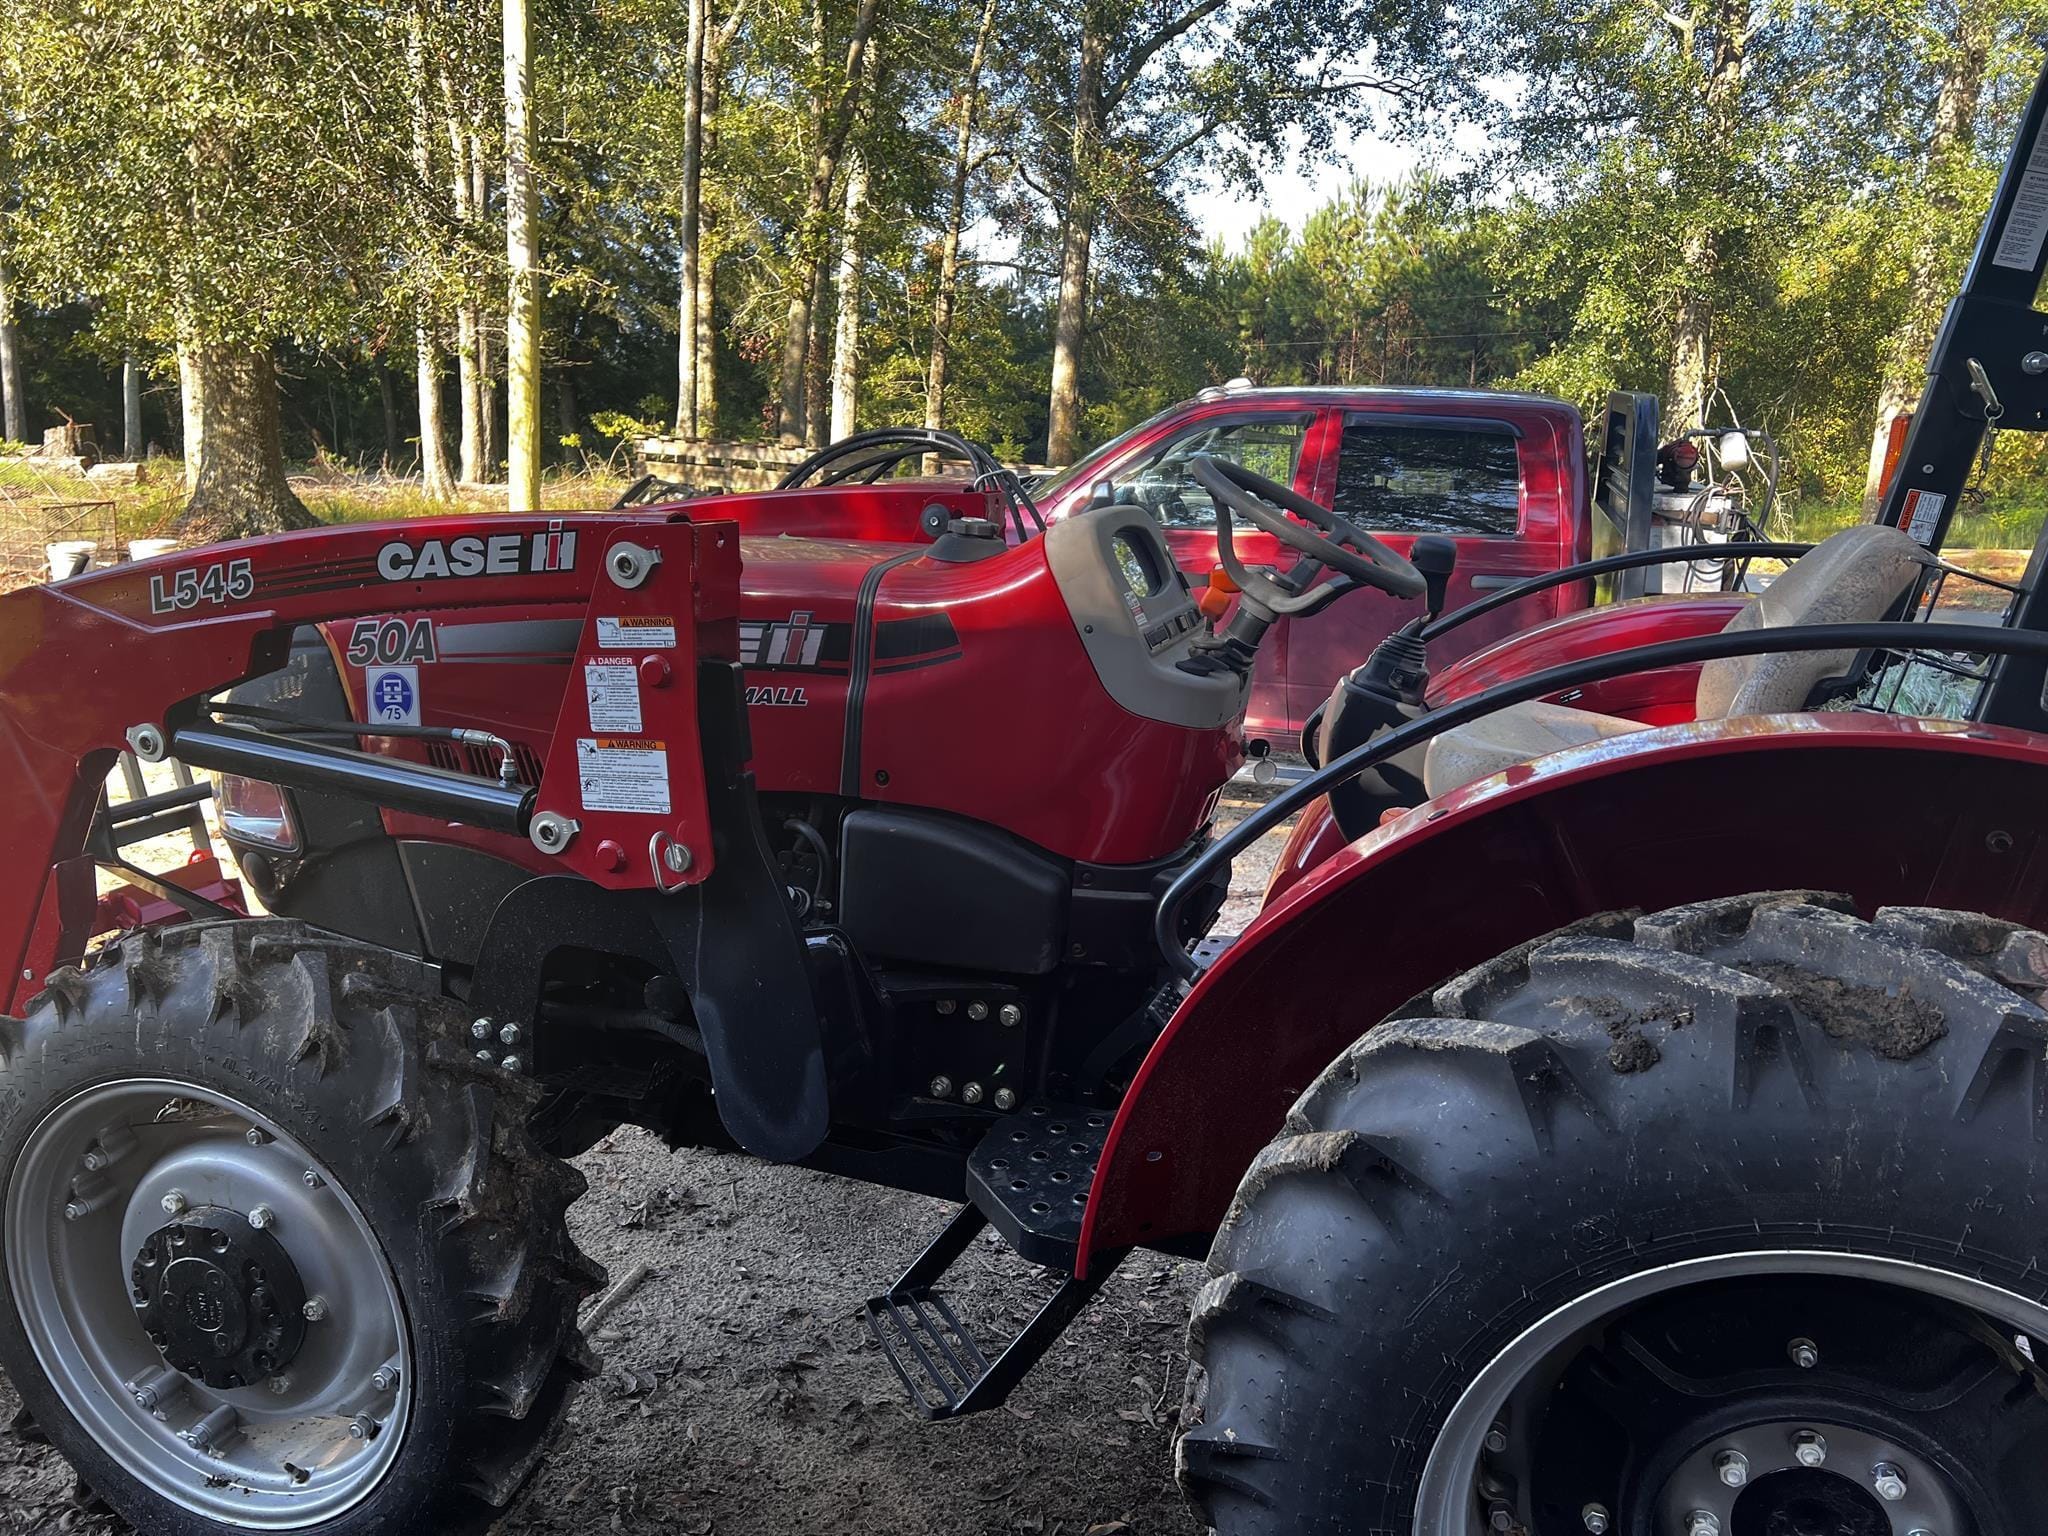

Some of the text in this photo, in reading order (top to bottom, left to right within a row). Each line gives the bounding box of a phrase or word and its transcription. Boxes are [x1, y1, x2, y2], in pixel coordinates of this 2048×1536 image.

[377, 536, 520, 581] CASE
[150, 558, 254, 615] L545
[629, 618, 672, 626] WARNING
[347, 618, 437, 667] 50A
[597, 657, 633, 665] DANGER
[386, 707, 401, 720] 75
[616, 740, 656, 749] WARNING
